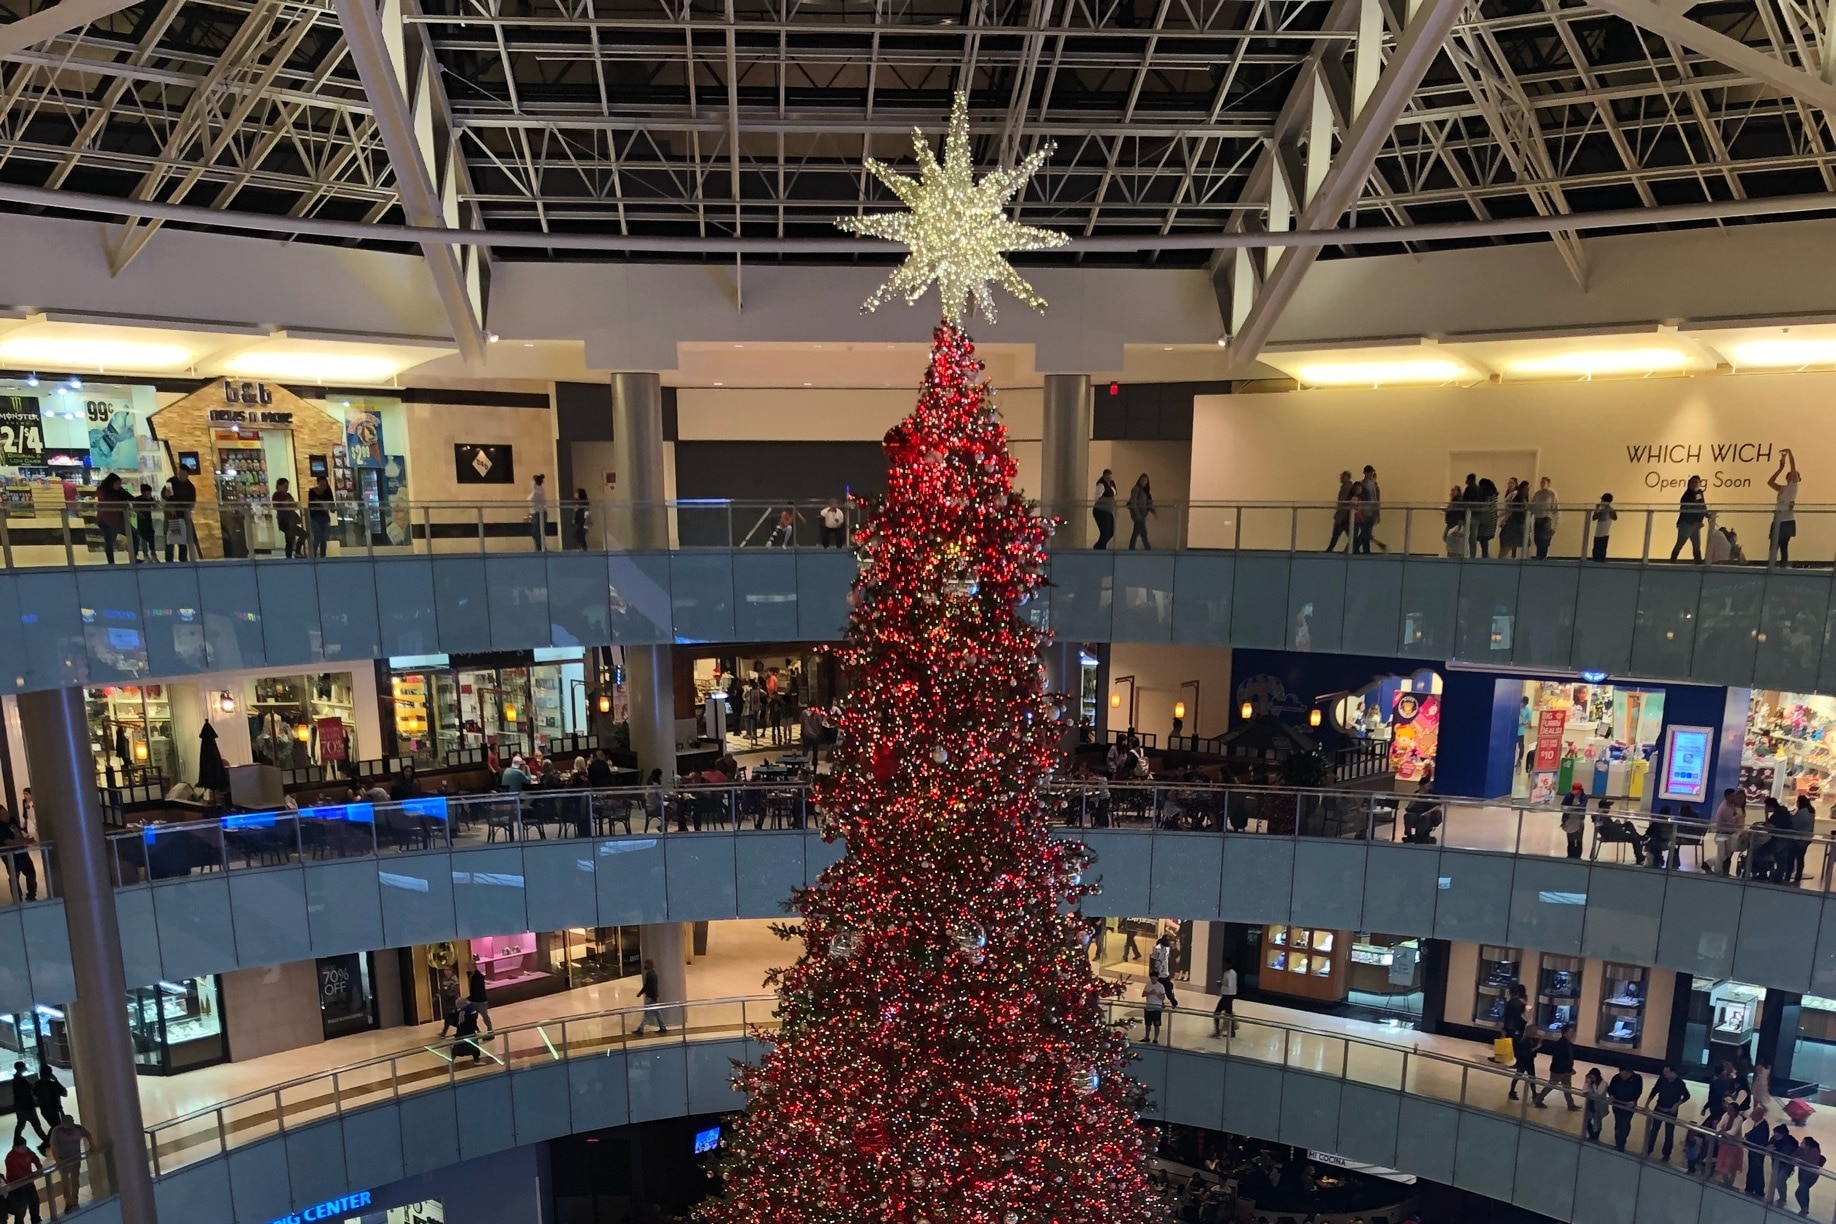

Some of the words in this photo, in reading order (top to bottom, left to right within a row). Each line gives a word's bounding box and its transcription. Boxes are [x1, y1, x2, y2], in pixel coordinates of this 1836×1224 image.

[223, 381, 272, 404] b&b
[0, 413, 39, 421] MONSTER
[1, 425, 43, 453] 2/$4
[1627, 444, 1701, 463] WHICH
[1711, 443, 1772, 462] WICH
[1713, 471, 1750, 488] Soon
[322, 968, 349, 984] 70%
[324, 981, 346, 995] OFF
[1309, 1150, 1317, 1159] MI
[1319, 1154, 1346, 1167] COCINA
[303, 1191, 372, 1222] CENTER
